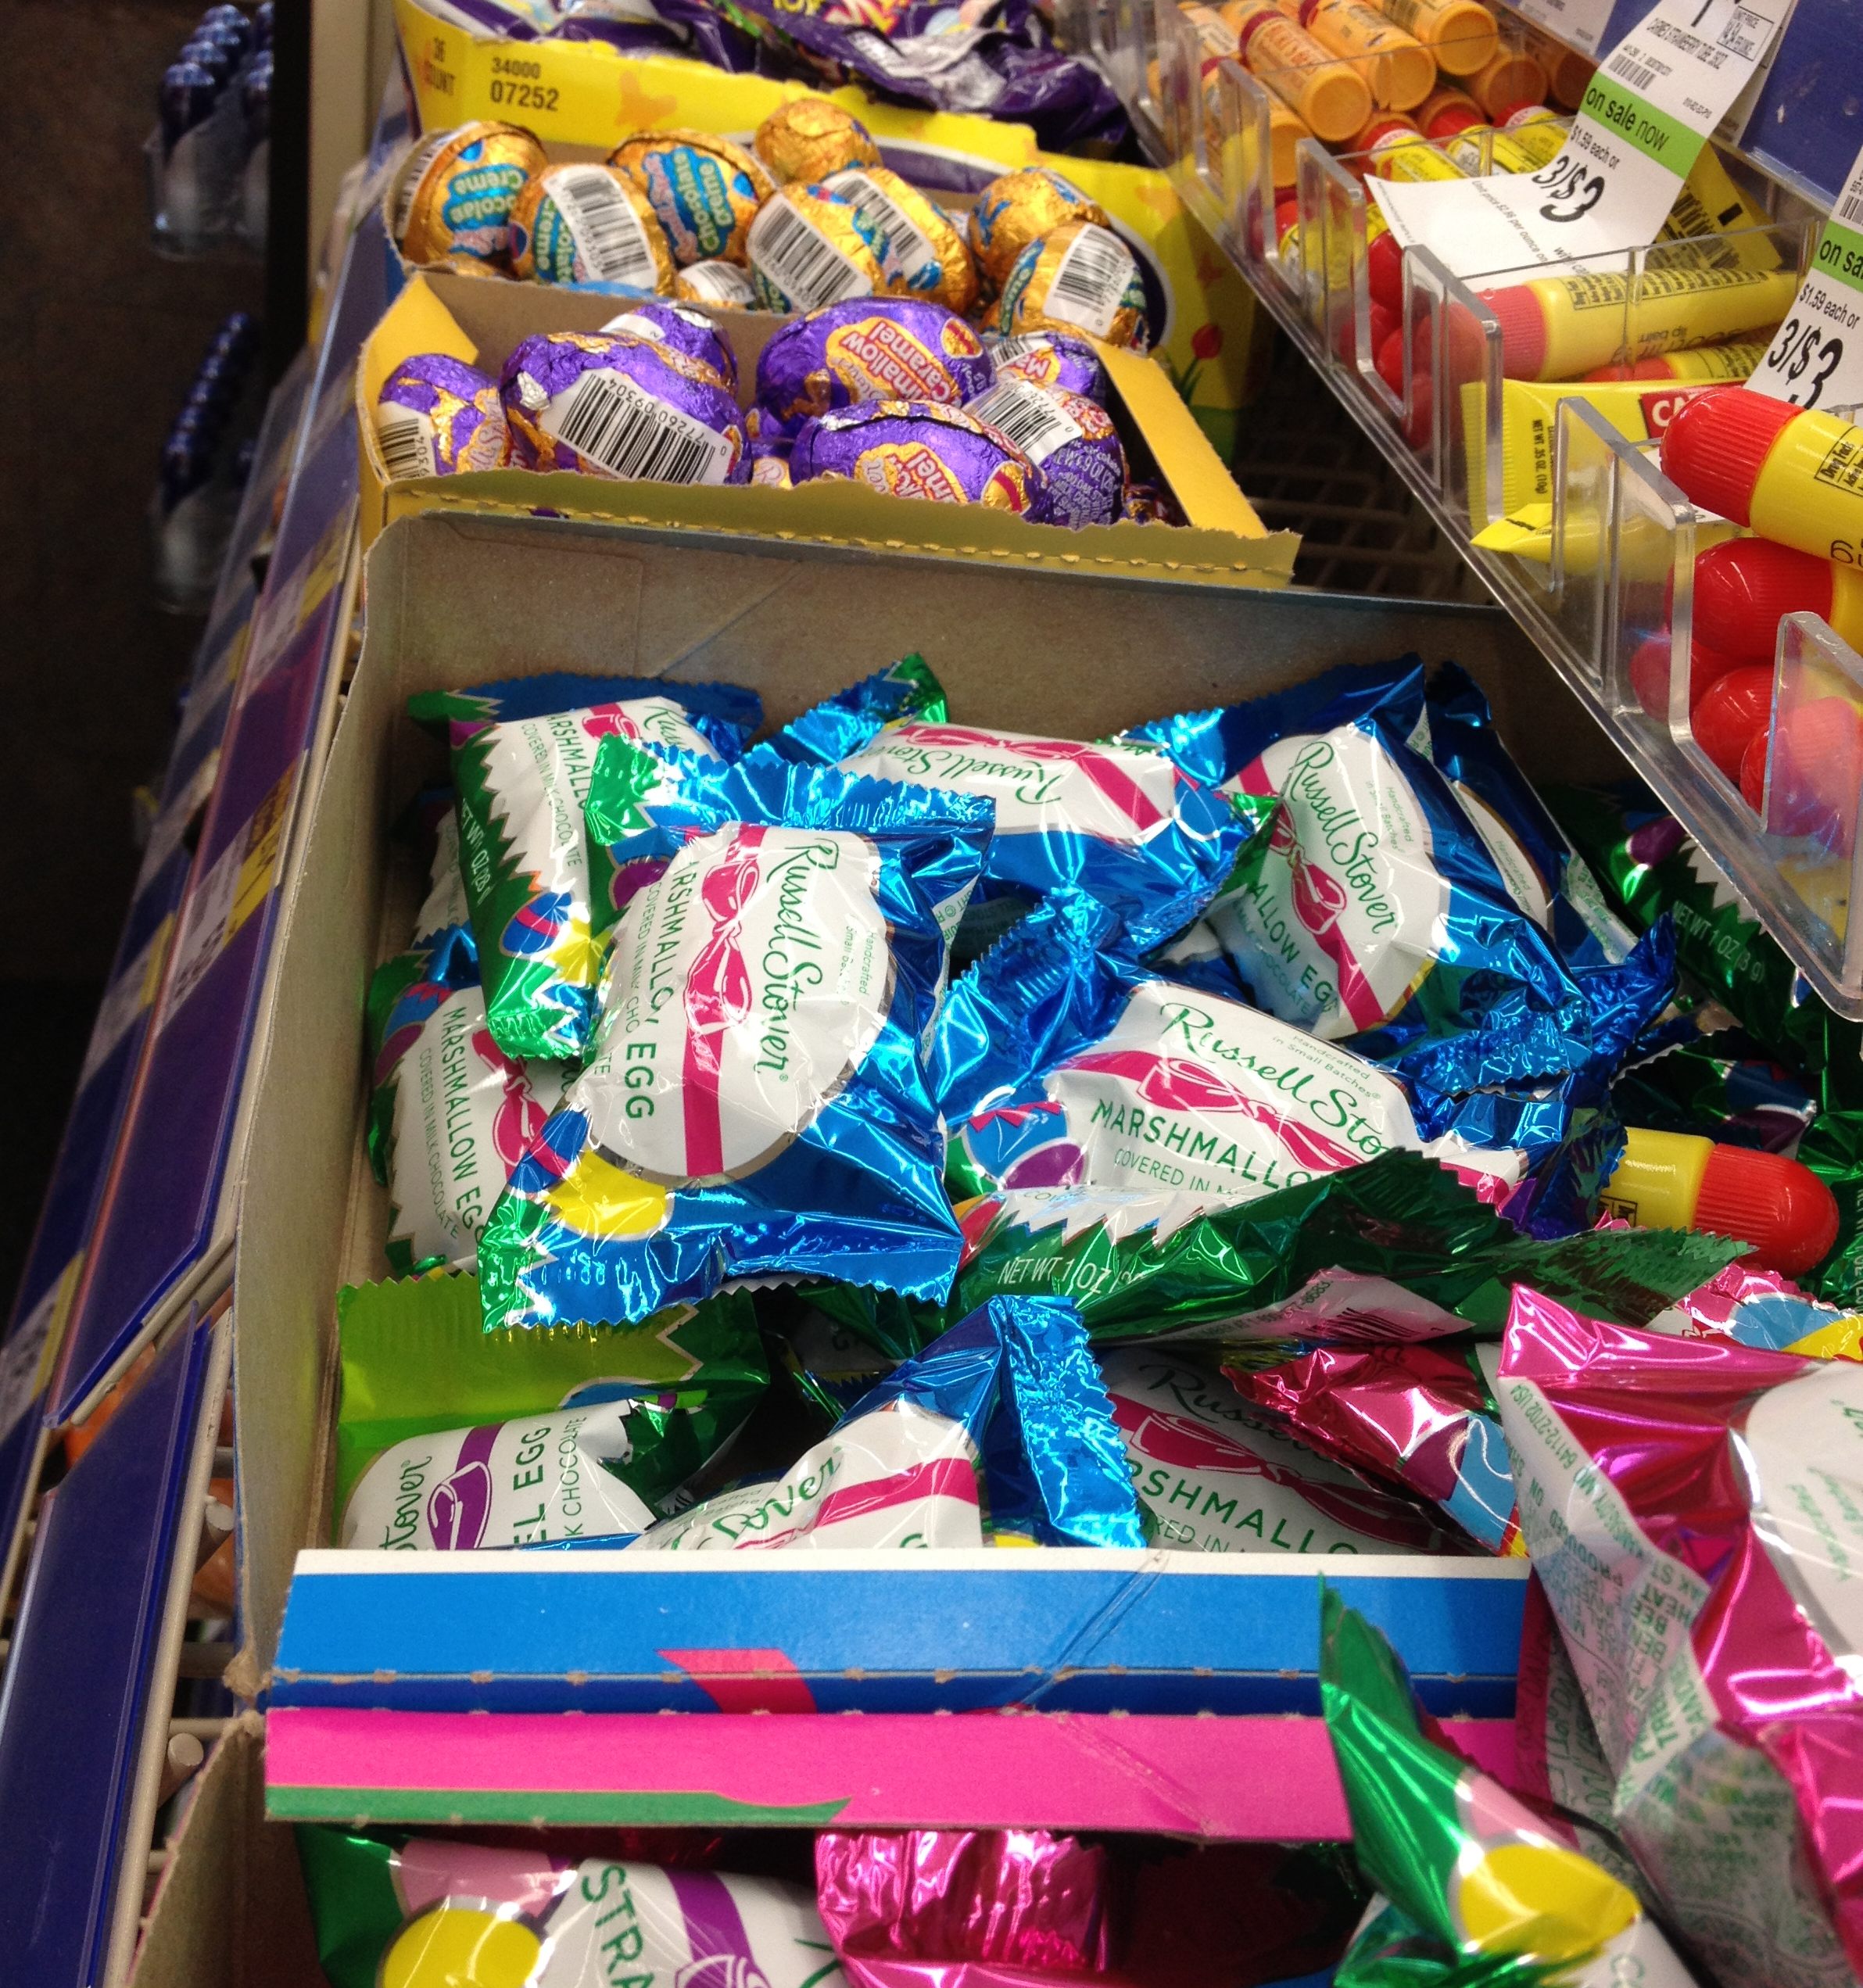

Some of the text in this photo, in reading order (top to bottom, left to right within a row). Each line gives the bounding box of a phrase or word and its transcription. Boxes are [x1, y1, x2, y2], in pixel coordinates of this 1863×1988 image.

[489, 80, 560, 111] 07252
[1585, 85, 1670, 152] on sale now
[1569, 125, 1621, 170] $1.59 each or
[699, 160, 725, 226] Creme
[1531, 154, 1605, 223] 3/$3
[1819, 239, 1840, 264] on
[1799, 282, 1825, 310] $1.59
[1822, 300, 1848, 323] each
[1847, 314, 1860, 328] or
[868, 320, 955, 403] Caramel
[608, 376, 654, 414] 09304
[660, 410, 706, 443] 77260
[1533, 433, 1545, 445] WT
[1820, 458, 1846, 479] Drug
[1289, 740, 1398, 935] Russell Stover
[1385, 785, 1415, 844] Handcrafted
[637, 880, 655, 940] COVERED
[766, 836, 840, 952] Russell
[1687, 913, 1712, 941] WT
[1716, 934, 1741, 962] OZ
[625, 861, 700, 1119] ARSHMALLO EGG
[1160, 1001, 1392, 1155] Russell Sto
[1271, 1034, 1287, 1046] in
[1287, 1041, 1324, 1066] Small
[1291, 1033, 1371, 1082] Handcrafted
[440, 1005, 478, 1182] MARSHMALLOW
[419, 1047, 460, 1240] COVERED IN MILK CHOCOLATE
[1113, 1149, 1186, 1187] COVERED
[998, 1255, 1034, 1284] NET
[1032, 1256, 1062, 1282] WT
[1076, 1262, 1110, 1295] OZ
[1510, 1383, 1535, 1407] USA
[513, 1425, 552, 1491] EGG
[1524, 1398, 1578, 1470] 64112-2702
[557, 1416, 589, 1517] CHOCOLATE
